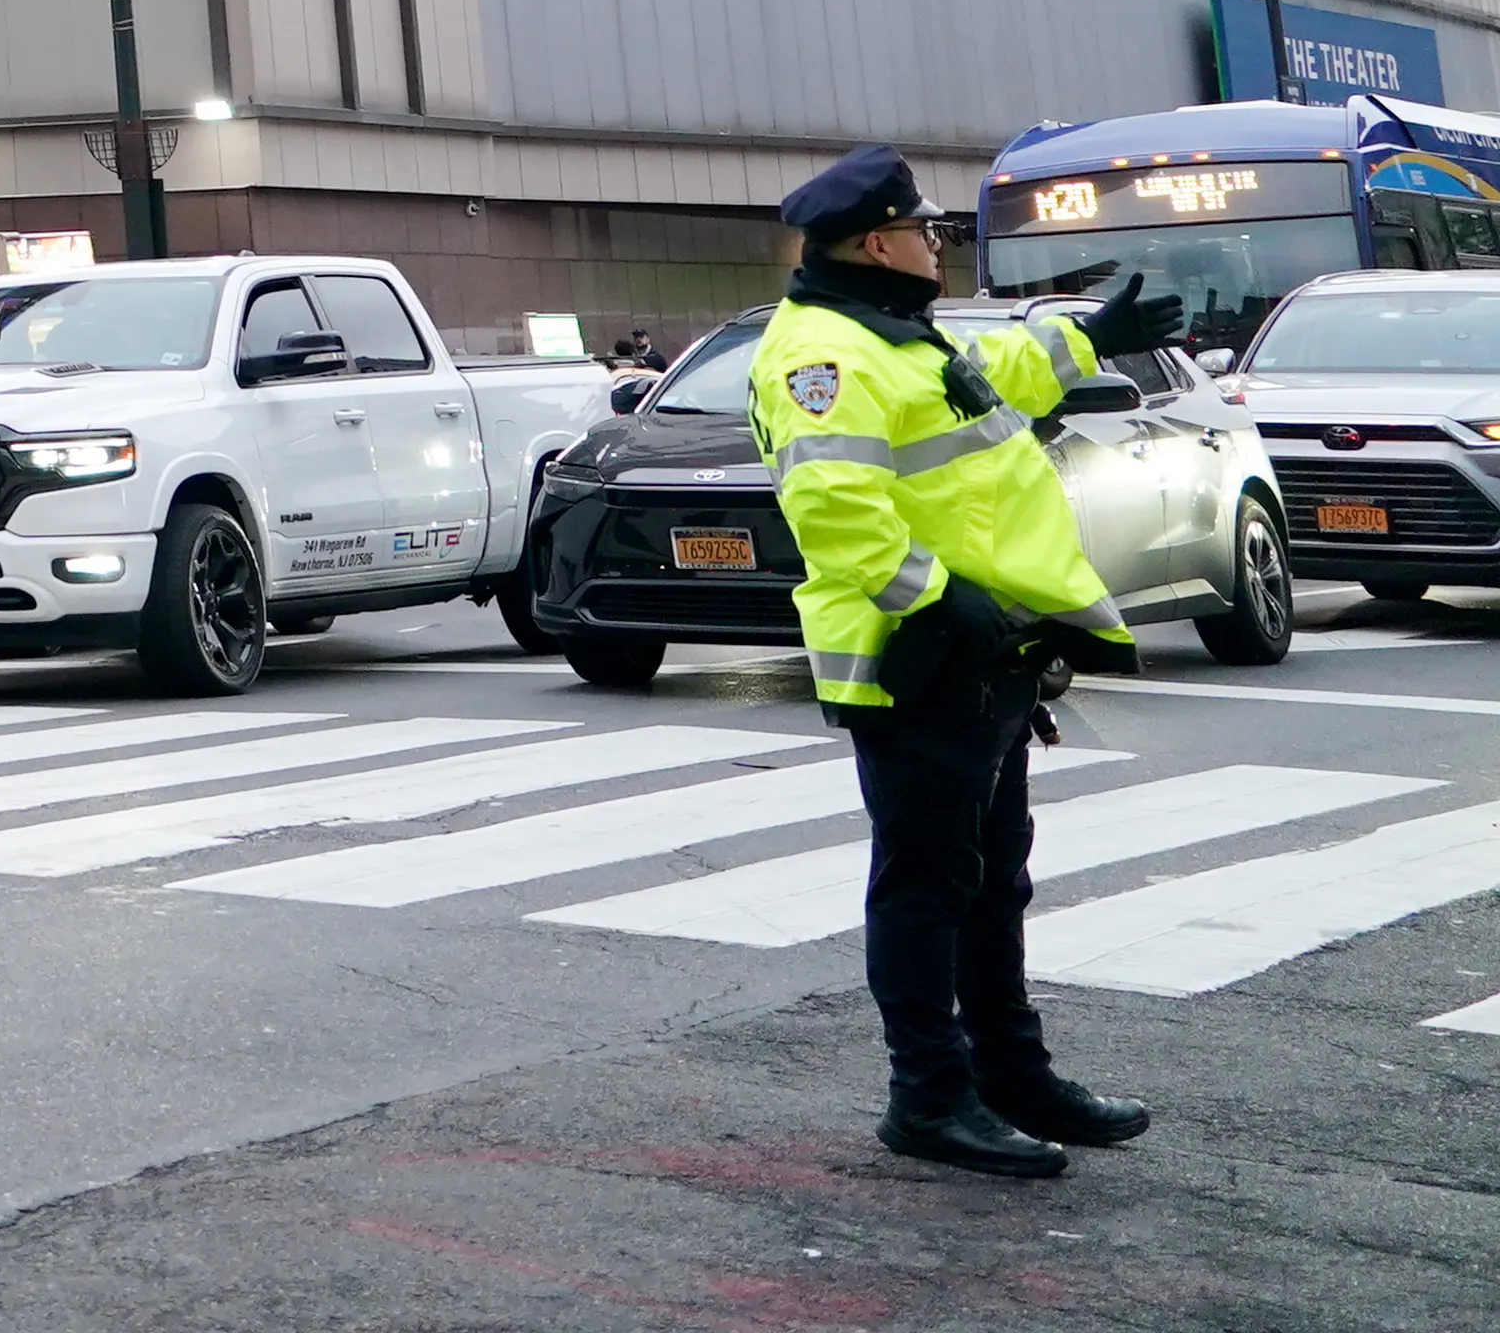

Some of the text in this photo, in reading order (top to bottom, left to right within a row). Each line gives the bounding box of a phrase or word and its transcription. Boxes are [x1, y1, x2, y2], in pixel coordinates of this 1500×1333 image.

[1284, 36, 1401, 92] THE THEATER
[1034, 181, 1099, 222] M20
[280, 512, 313, 524] RAM
[303, 539, 318, 554] 341
[354, 535, 367, 548] Rd
[393, 526, 463, 552] ELITE
[290, 557, 336, 572] Hawthorne,
[392, 551, 432, 561] MECHANICAL
